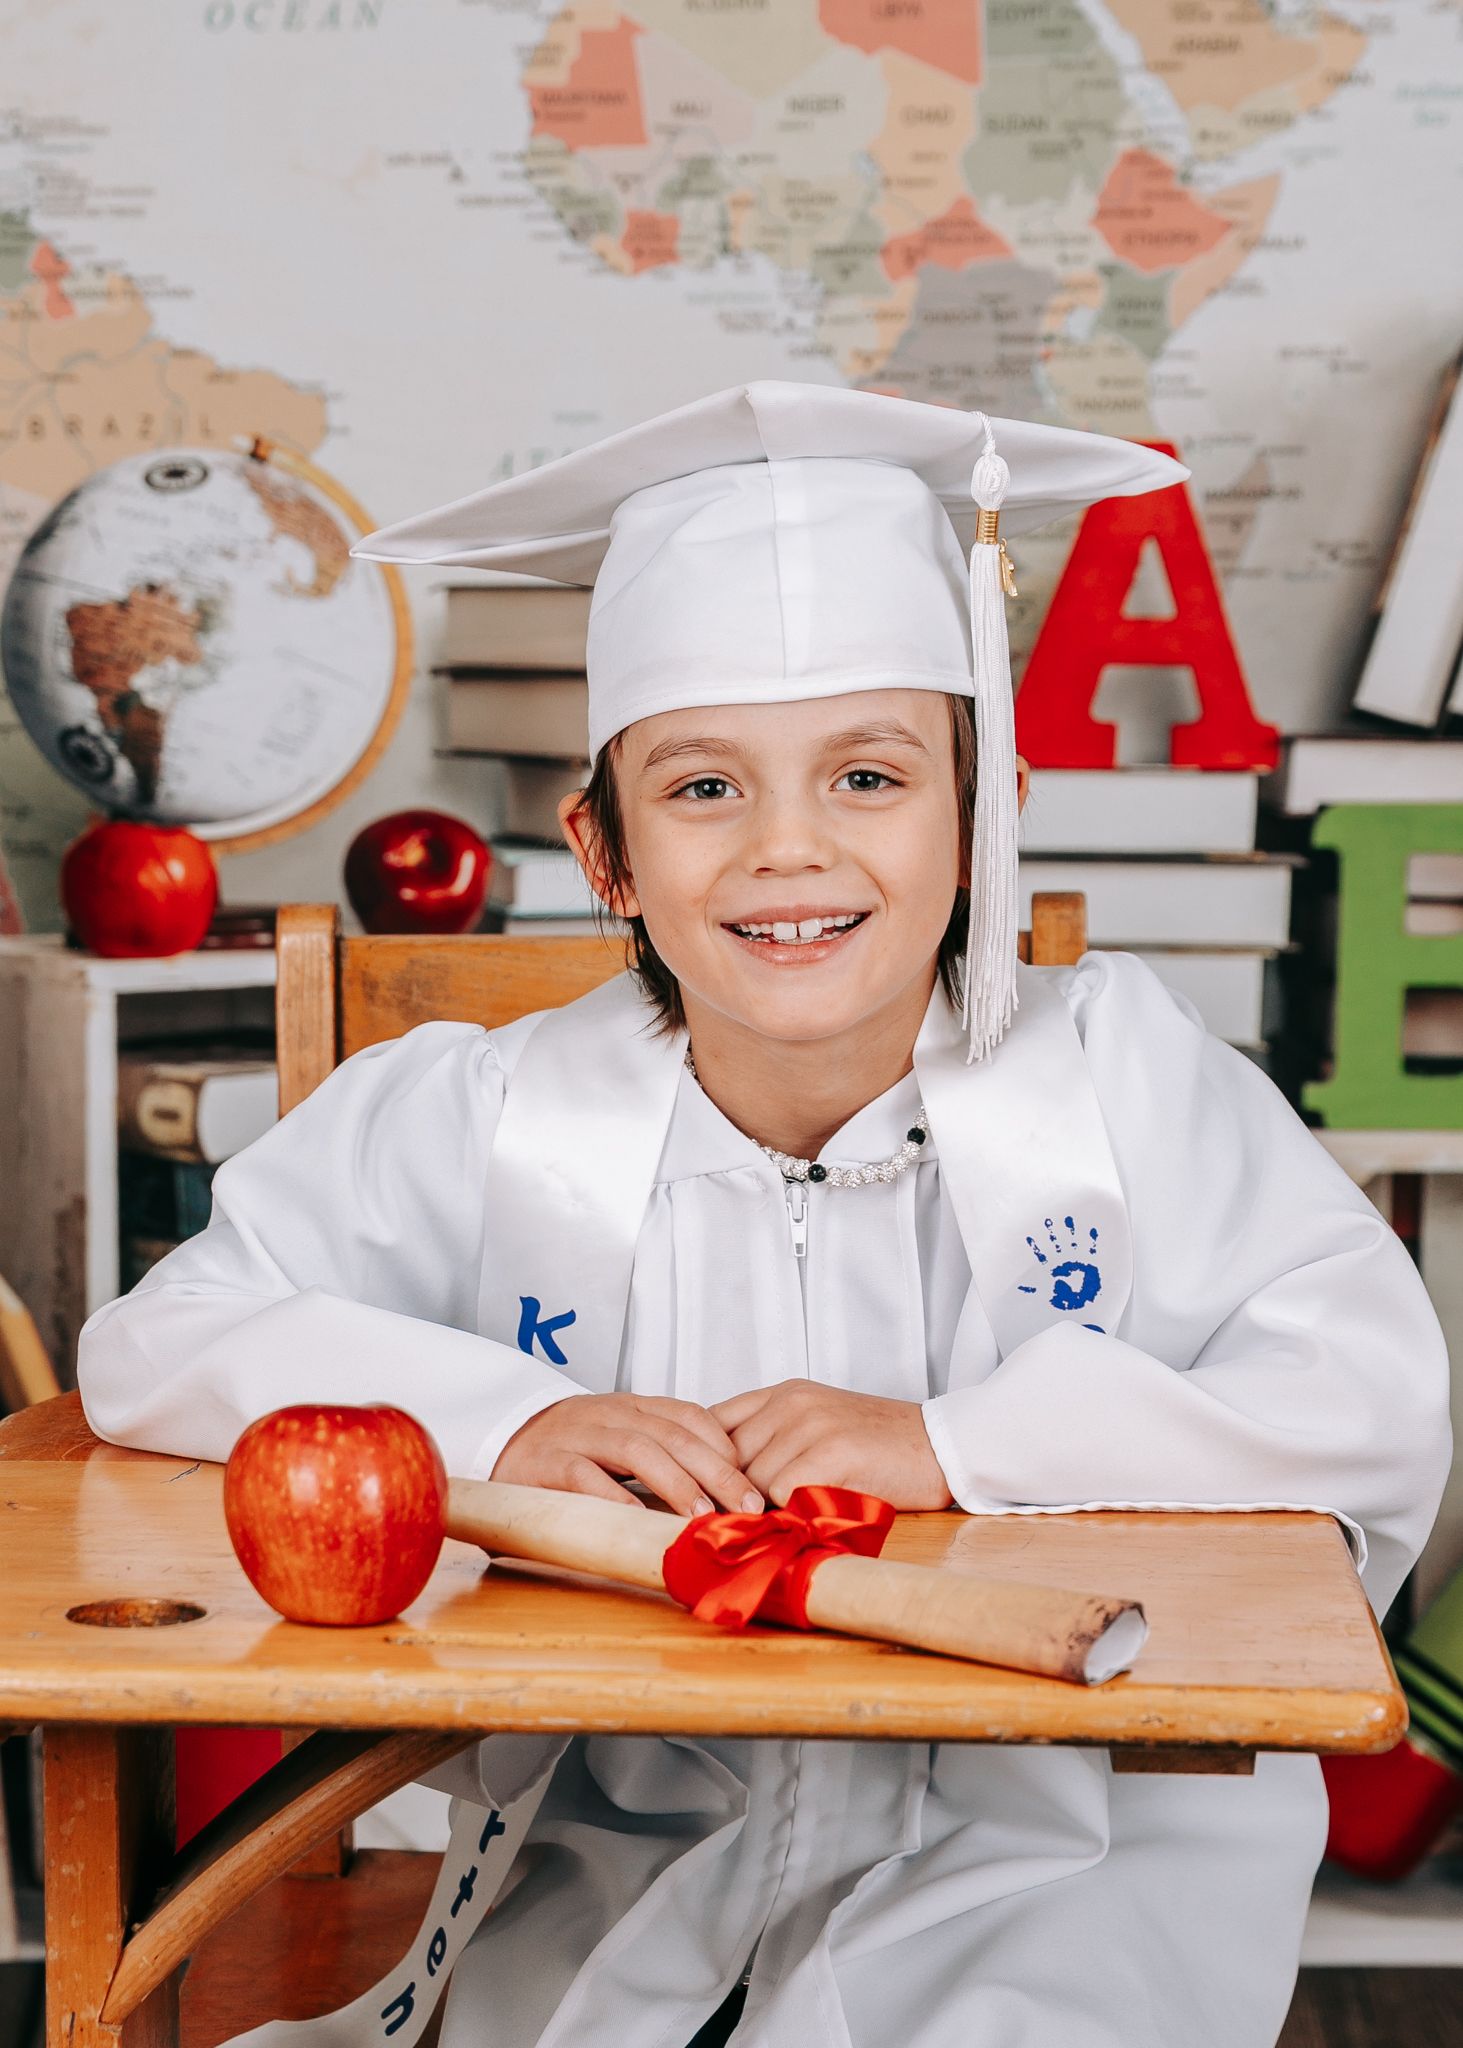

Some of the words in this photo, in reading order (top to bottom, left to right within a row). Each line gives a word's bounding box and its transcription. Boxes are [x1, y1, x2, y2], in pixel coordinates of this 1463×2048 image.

[202, 0, 386, 34] OCEAN
[26, 413, 215, 442] BRAZIL
[1014, 440, 1283, 773] A
[517, 1295, 577, 1366] K
